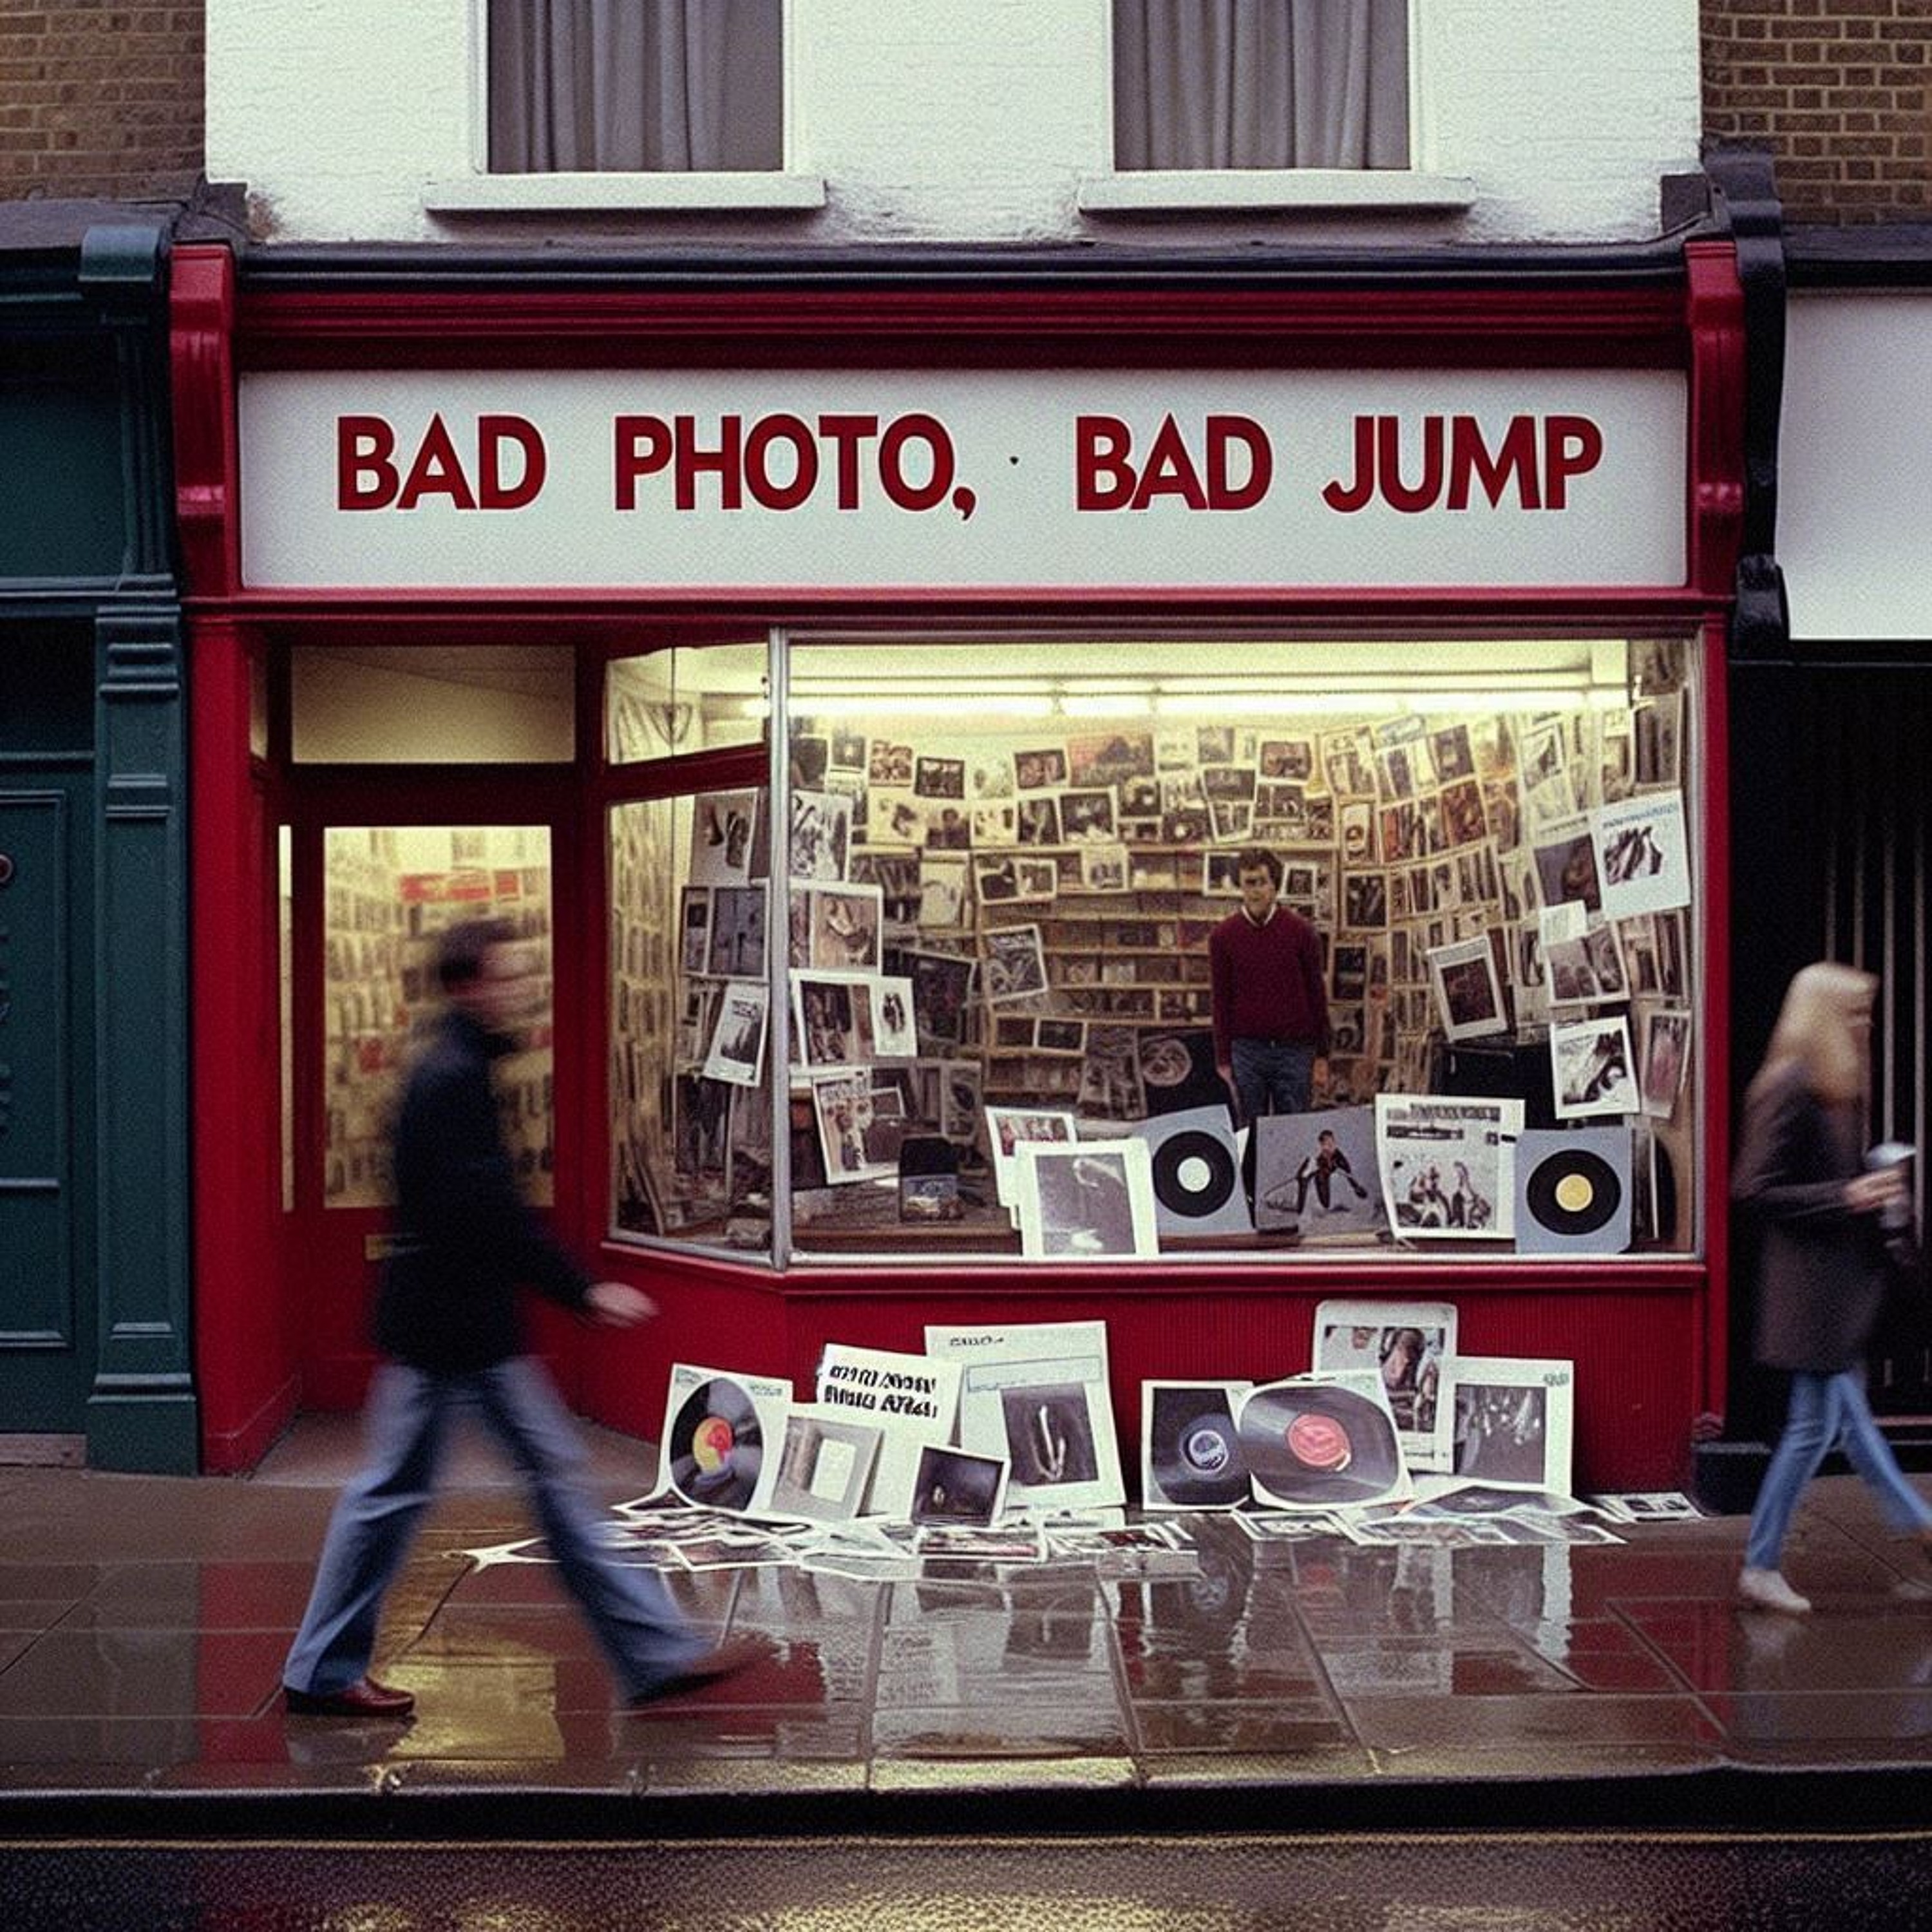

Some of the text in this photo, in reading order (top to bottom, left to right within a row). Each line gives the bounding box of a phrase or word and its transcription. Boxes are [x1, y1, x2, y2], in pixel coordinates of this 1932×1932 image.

[338, 413, 1602, 520] BAD PHOTO, BAD JUMP
